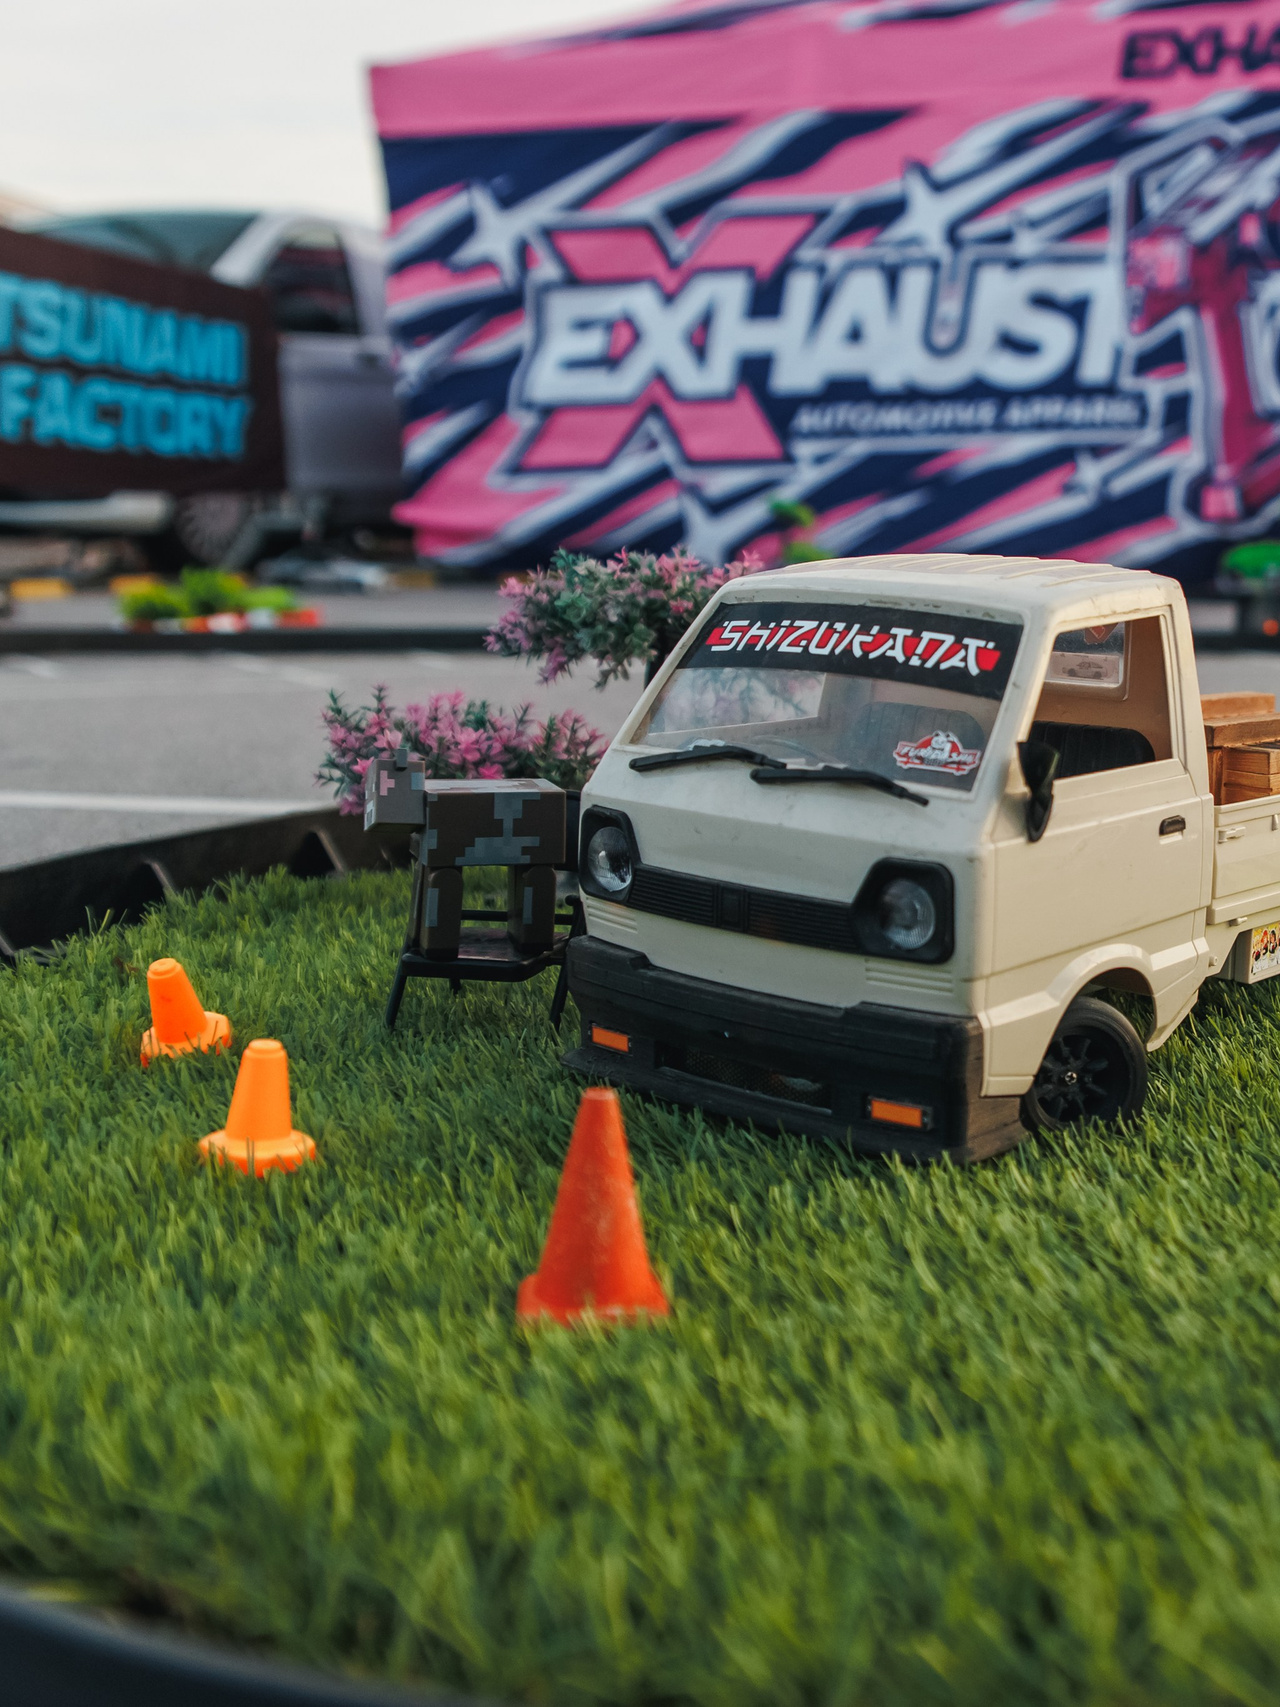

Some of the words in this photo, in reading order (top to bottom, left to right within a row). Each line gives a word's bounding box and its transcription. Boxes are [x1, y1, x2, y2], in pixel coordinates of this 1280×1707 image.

[0, 270, 246, 384] TSUNAMI
[528, 258, 1130, 402] EXHAUST
[0, 363, 248, 458] FACTORY
